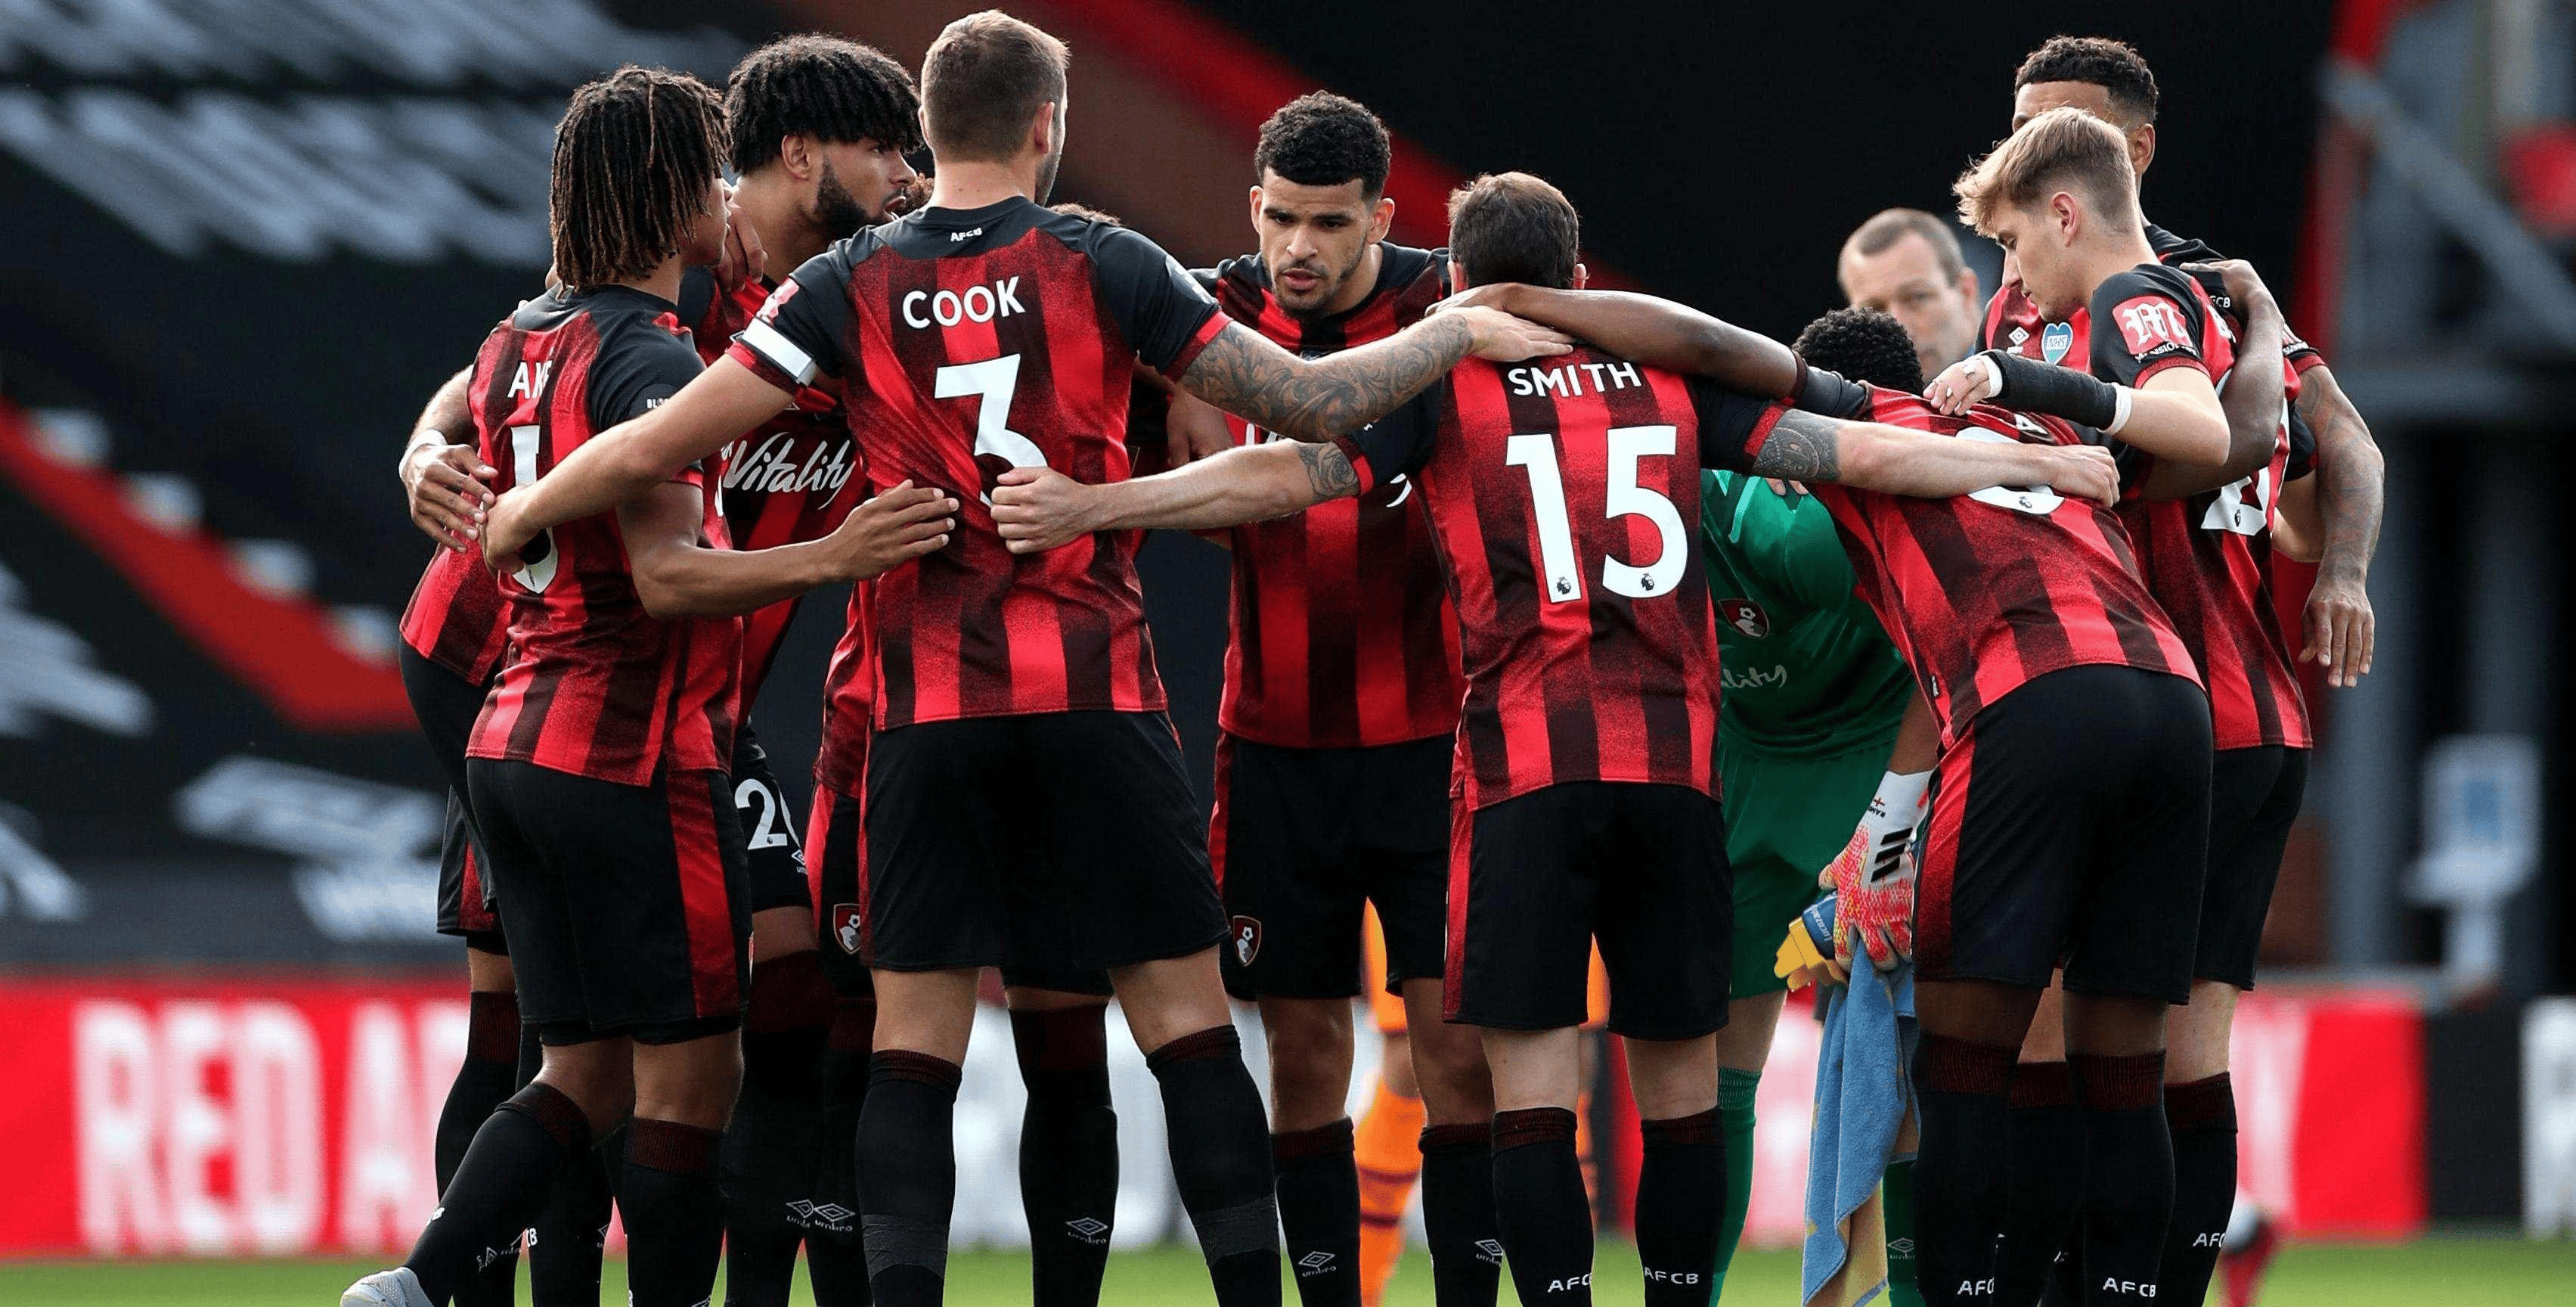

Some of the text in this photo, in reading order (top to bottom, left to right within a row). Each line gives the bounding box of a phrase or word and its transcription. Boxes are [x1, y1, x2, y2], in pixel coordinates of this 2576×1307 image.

[950, 227, 983, 242] AFCB
[902, 275, 1026, 329] COOK
[2050, 337, 2067, 348] NHS
[1508, 362, 1642, 398] SMITH
[723, 431, 857, 511] Vitality
[1505, 424, 1688, 604] 15
[1720, 663, 1788, 689] lity
[734, 778, 802, 851] 2
[73, 998, 323, 1253] RED
[2193, 1232, 2226, 1248] AFC
[1547, 1272, 1592, 1293] AFC
[1644, 1266, 1700, 1285] AFCB
[1957, 1277, 1995, 1296] AFC
[2103, 1277, 2156, 1298] AFCB
